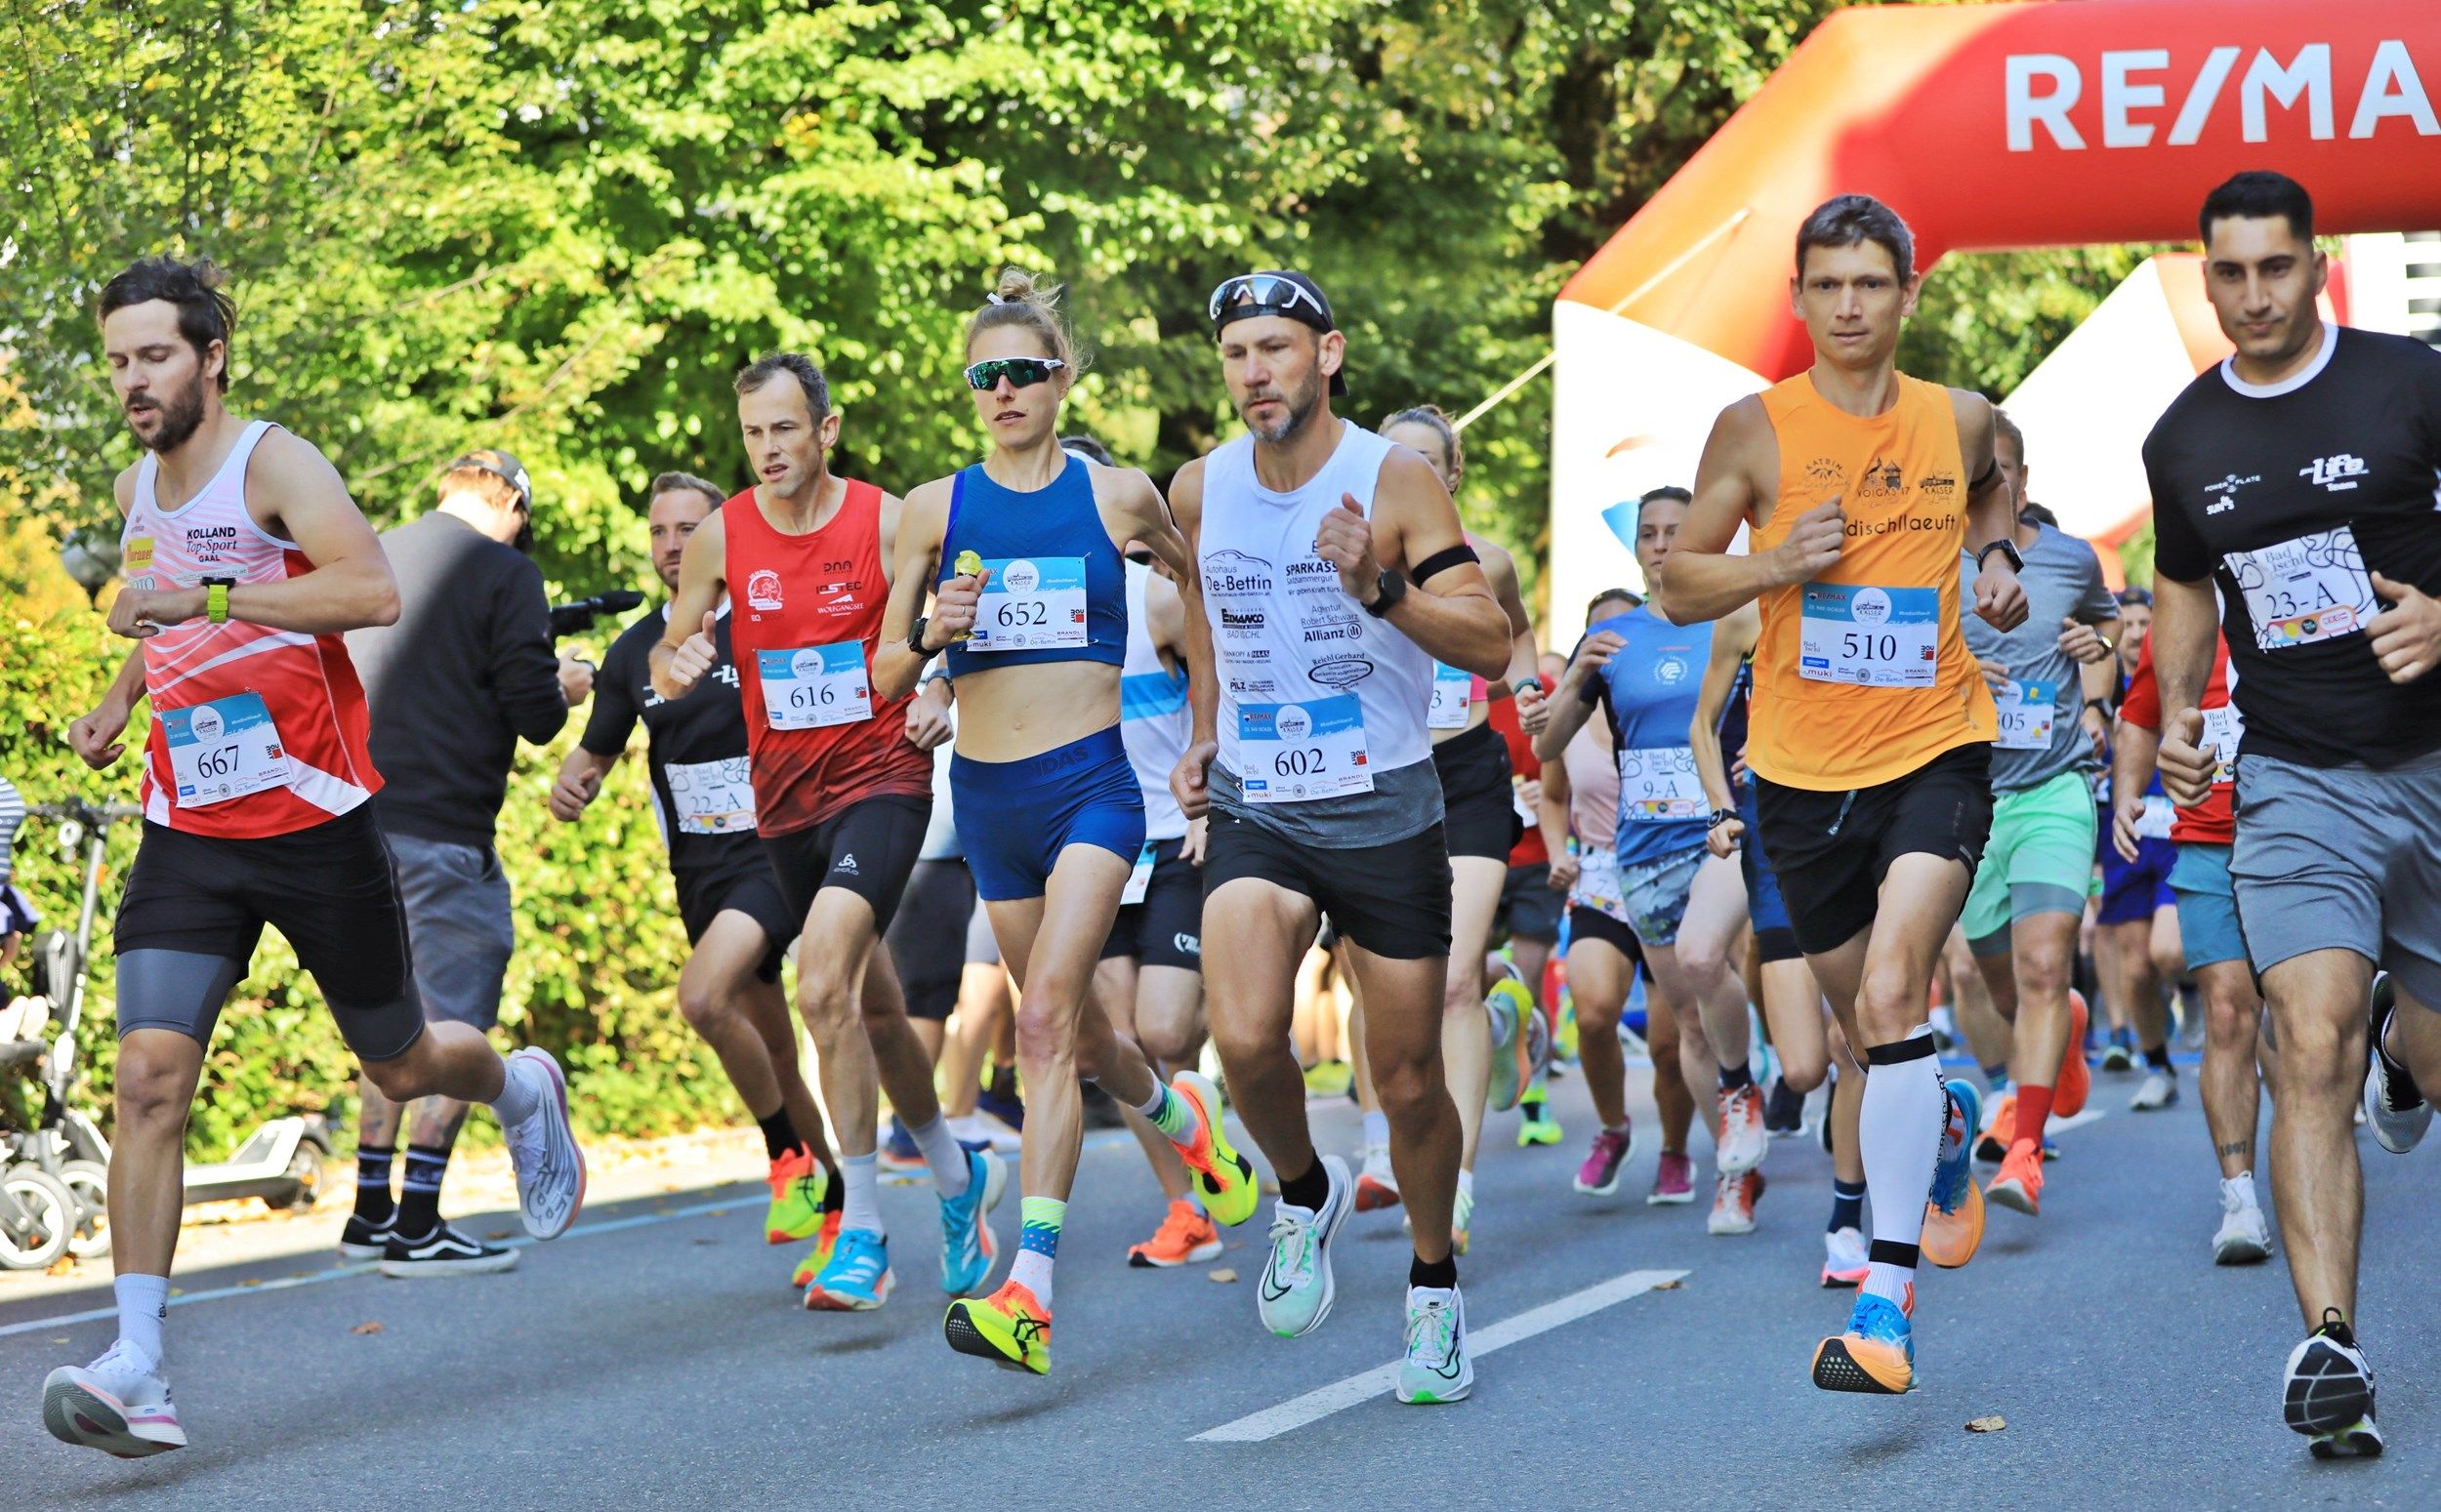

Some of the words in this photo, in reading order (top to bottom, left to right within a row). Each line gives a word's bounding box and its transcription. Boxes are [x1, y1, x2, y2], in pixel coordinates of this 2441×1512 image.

[2005, 39, 2441, 151] RE/MA
[186, 527, 237, 540] KOLLAND
[1846, 514, 1955, 537] dischllaeuft
[186, 539, 237, 554] Top-Sport
[2264, 546, 2292, 563] Bad
[1206, 565, 1237, 574] Autohaus
[1286, 561, 1339, 577] SPARKASS
[1206, 574, 1272, 591] De-Bettin
[2265, 582, 2338, 619] 23-A
[998, 601, 1048, 627] 652
[1311, 604, 1342, 615] Agentur
[1301, 617, 1325, 627] Robert
[1327, 613, 1358, 623] Schwarz
[1304, 630, 1345, 642] Allianz
[1842, 633, 1896, 661] 510
[1312, 654, 1334, 665] Reichl
[1807, 669, 1833, 677] muki
[791, 683, 835, 709] 616
[1998, 712, 2025, 731] 05
[197, 744, 239, 779] 667
[1275, 748, 1327, 777] 602
[1643, 781, 1679, 798] 9-A
[690, 793, 743, 813] 22-A
